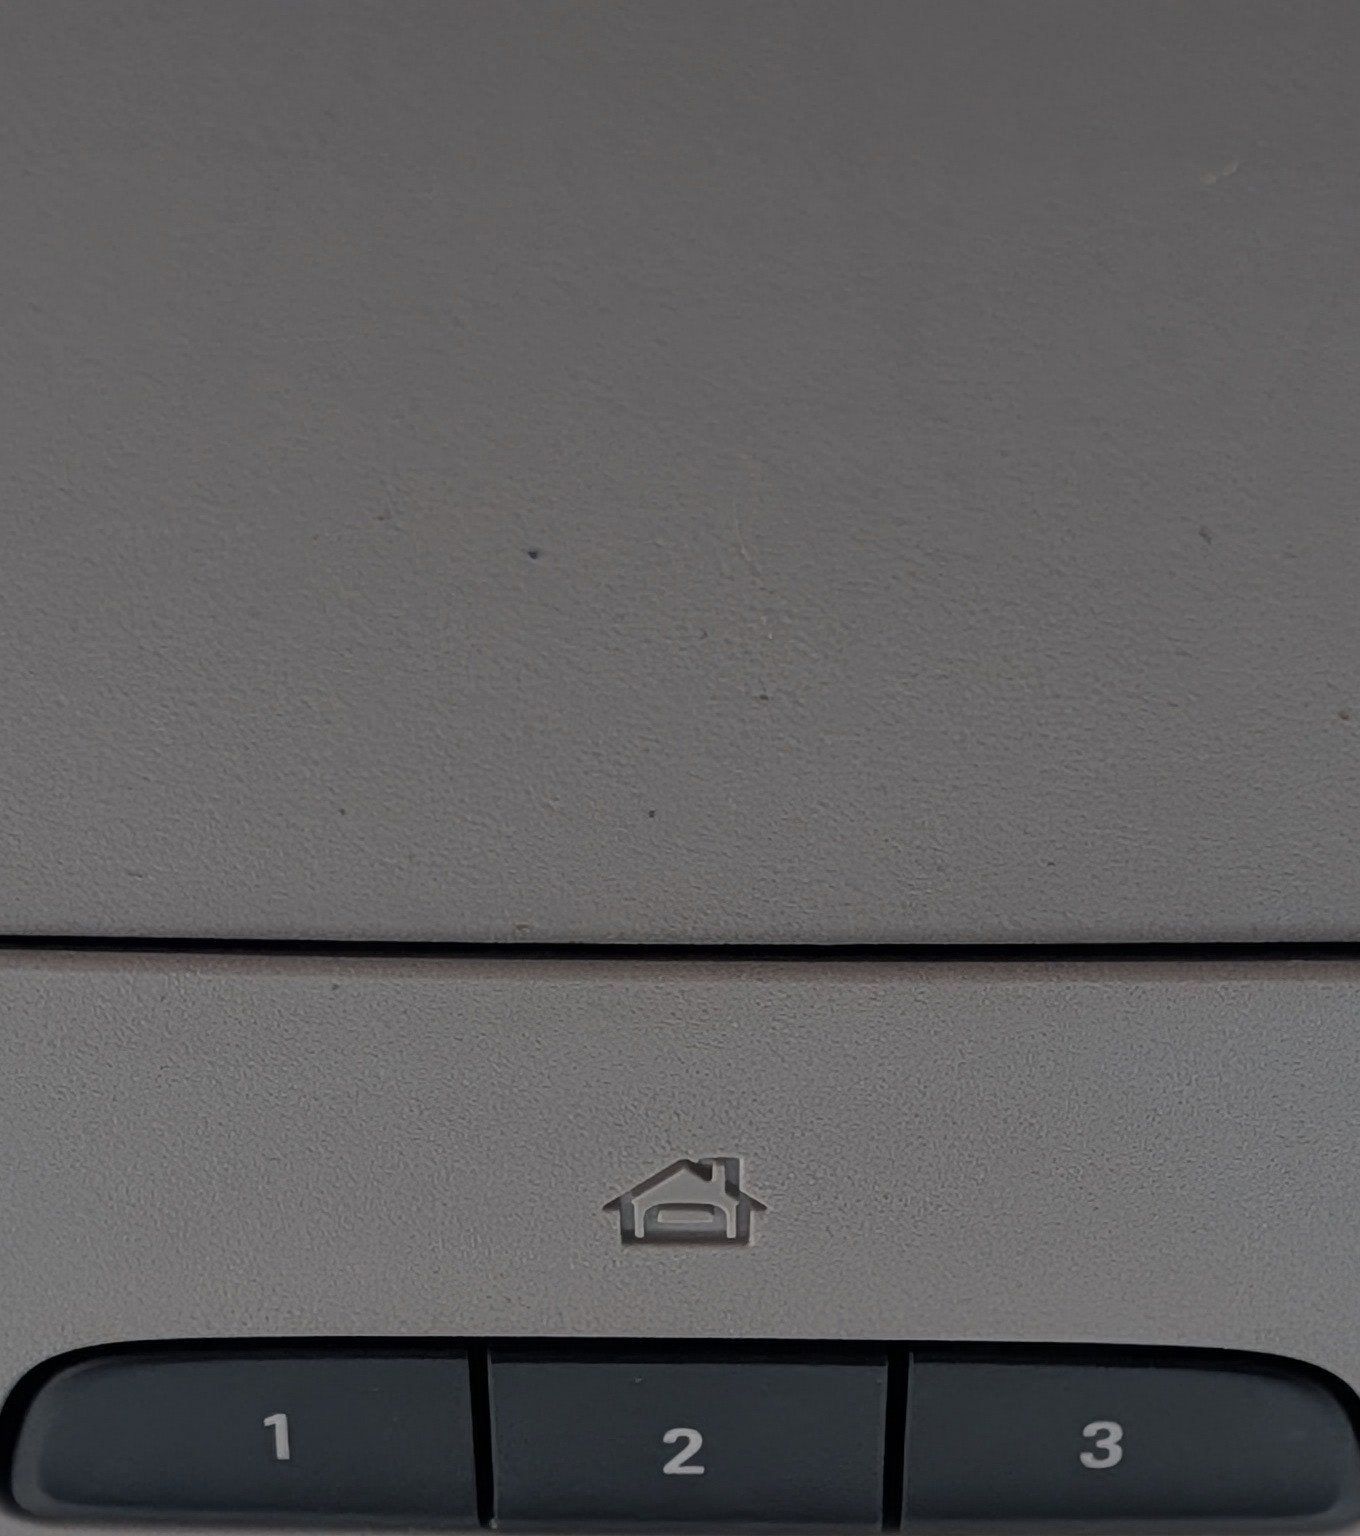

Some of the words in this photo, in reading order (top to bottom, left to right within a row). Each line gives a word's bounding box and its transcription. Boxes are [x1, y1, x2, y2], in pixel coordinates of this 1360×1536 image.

[262, 1411, 291, 1461] 1
[661, 1426, 706, 1476] 2
[1079, 1420, 1124, 1470] 3
